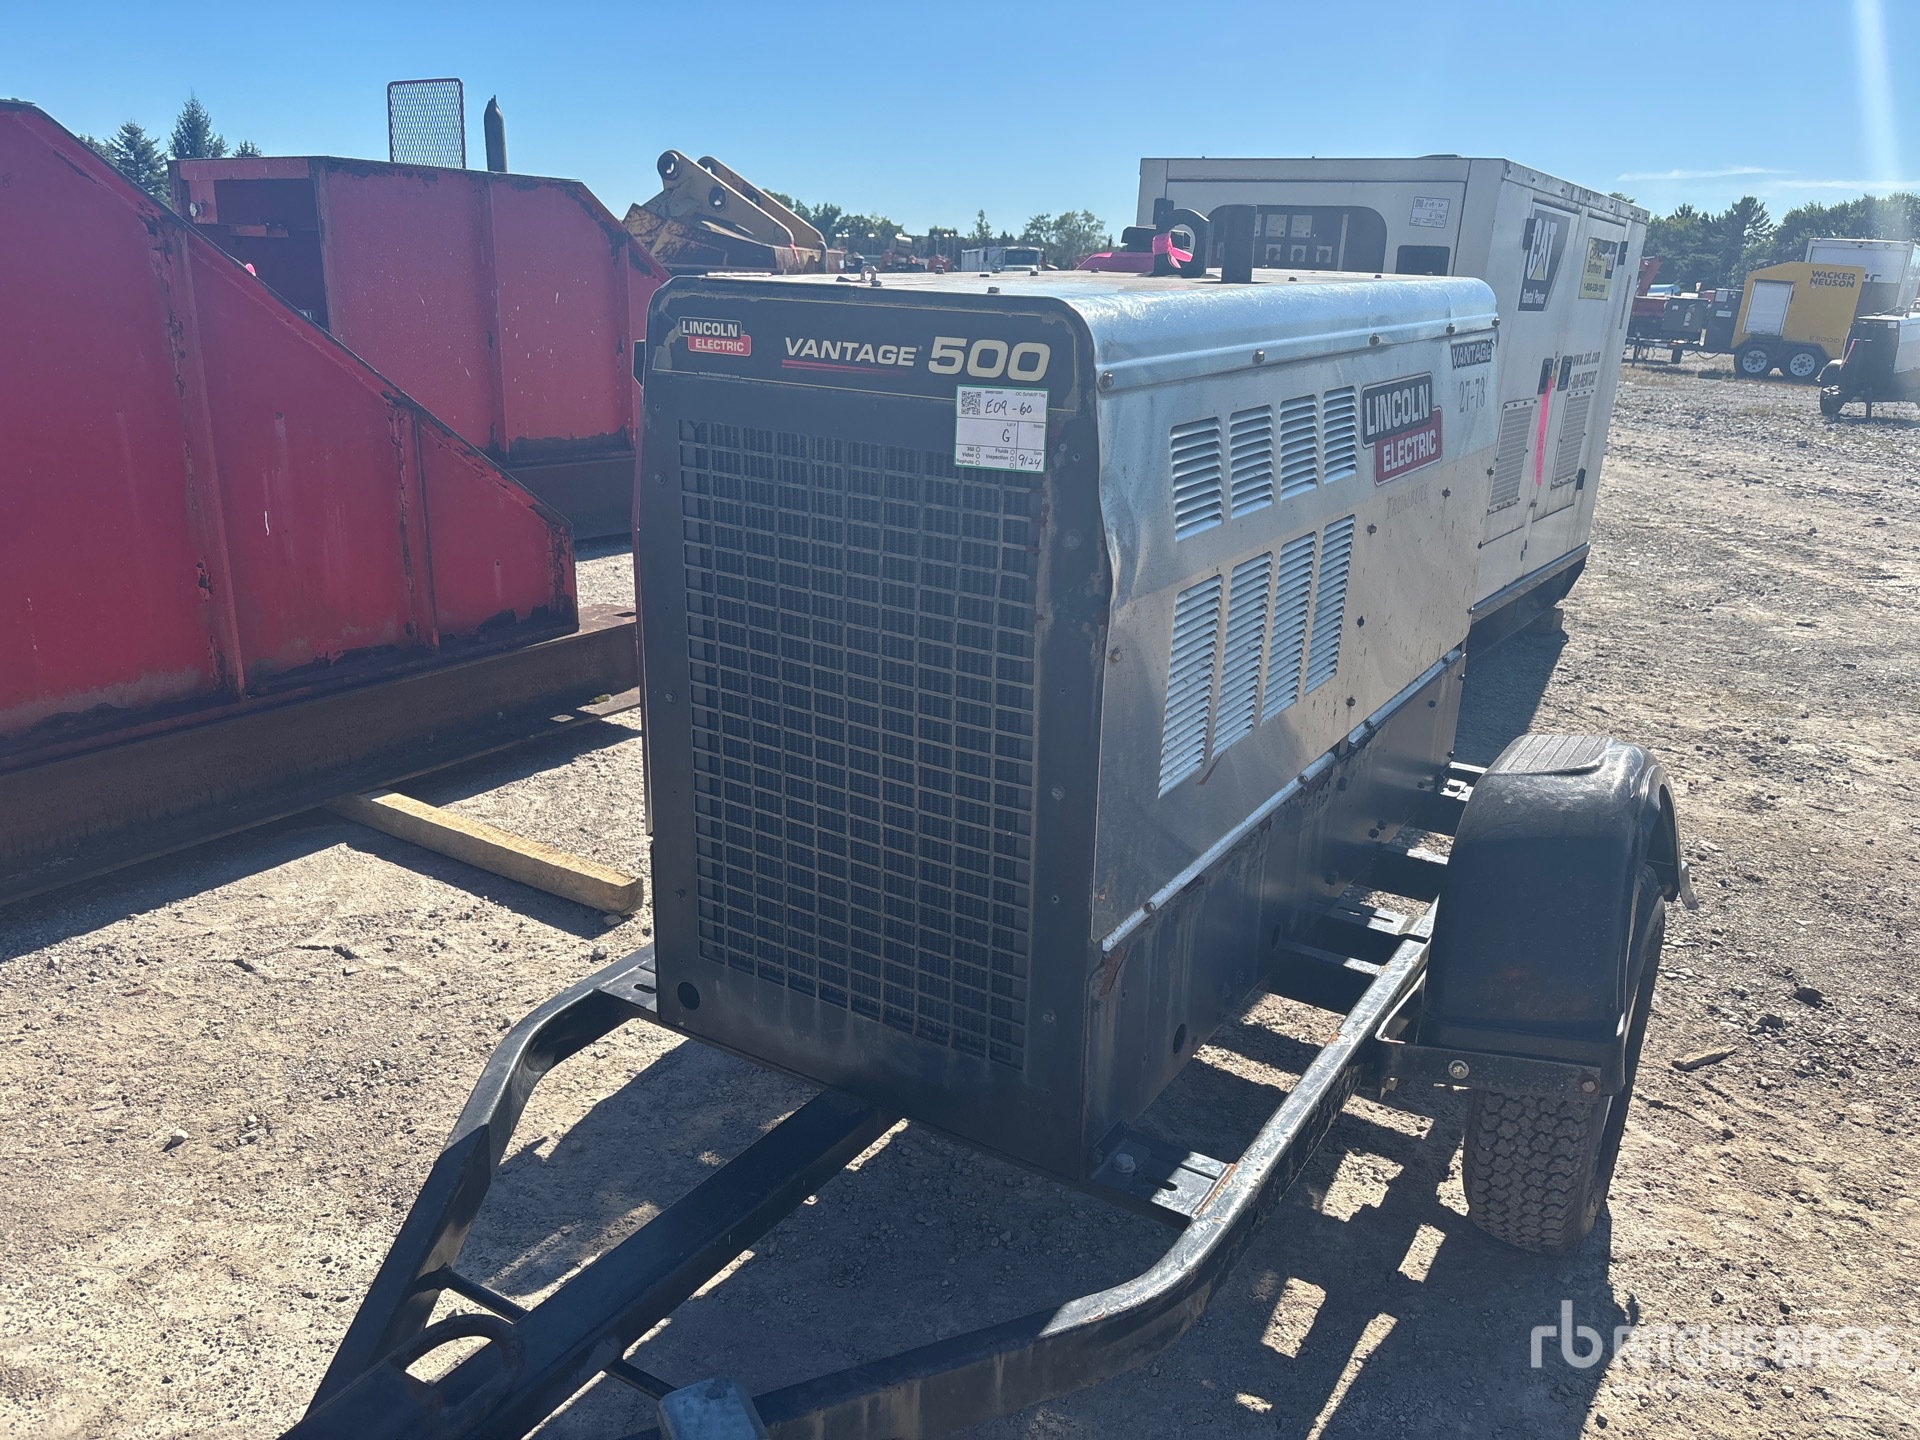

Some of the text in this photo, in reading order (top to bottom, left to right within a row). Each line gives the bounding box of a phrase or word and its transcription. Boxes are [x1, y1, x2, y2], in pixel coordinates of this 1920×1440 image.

[1527, 218, 1558, 281] CAT
[1810, 278, 1855, 288] NEUSON
[1812, 270, 1856, 280] WACKER
[682, 321, 738, 337] LINCOLN
[695, 339, 744, 352] ELECTRIC
[1451, 341, 1492, 369] VANTAGE
[784, 336, 1051, 382] VANTAGE 500
[1459, 377, 1486, 413] 27-73
[1366, 383, 1430, 436] LINCOLN
[1002, 428, 1011, 443] G
[1018, 454, 1041, 470] 9/24
[1383, 429, 1436, 473] ELECTRIC
